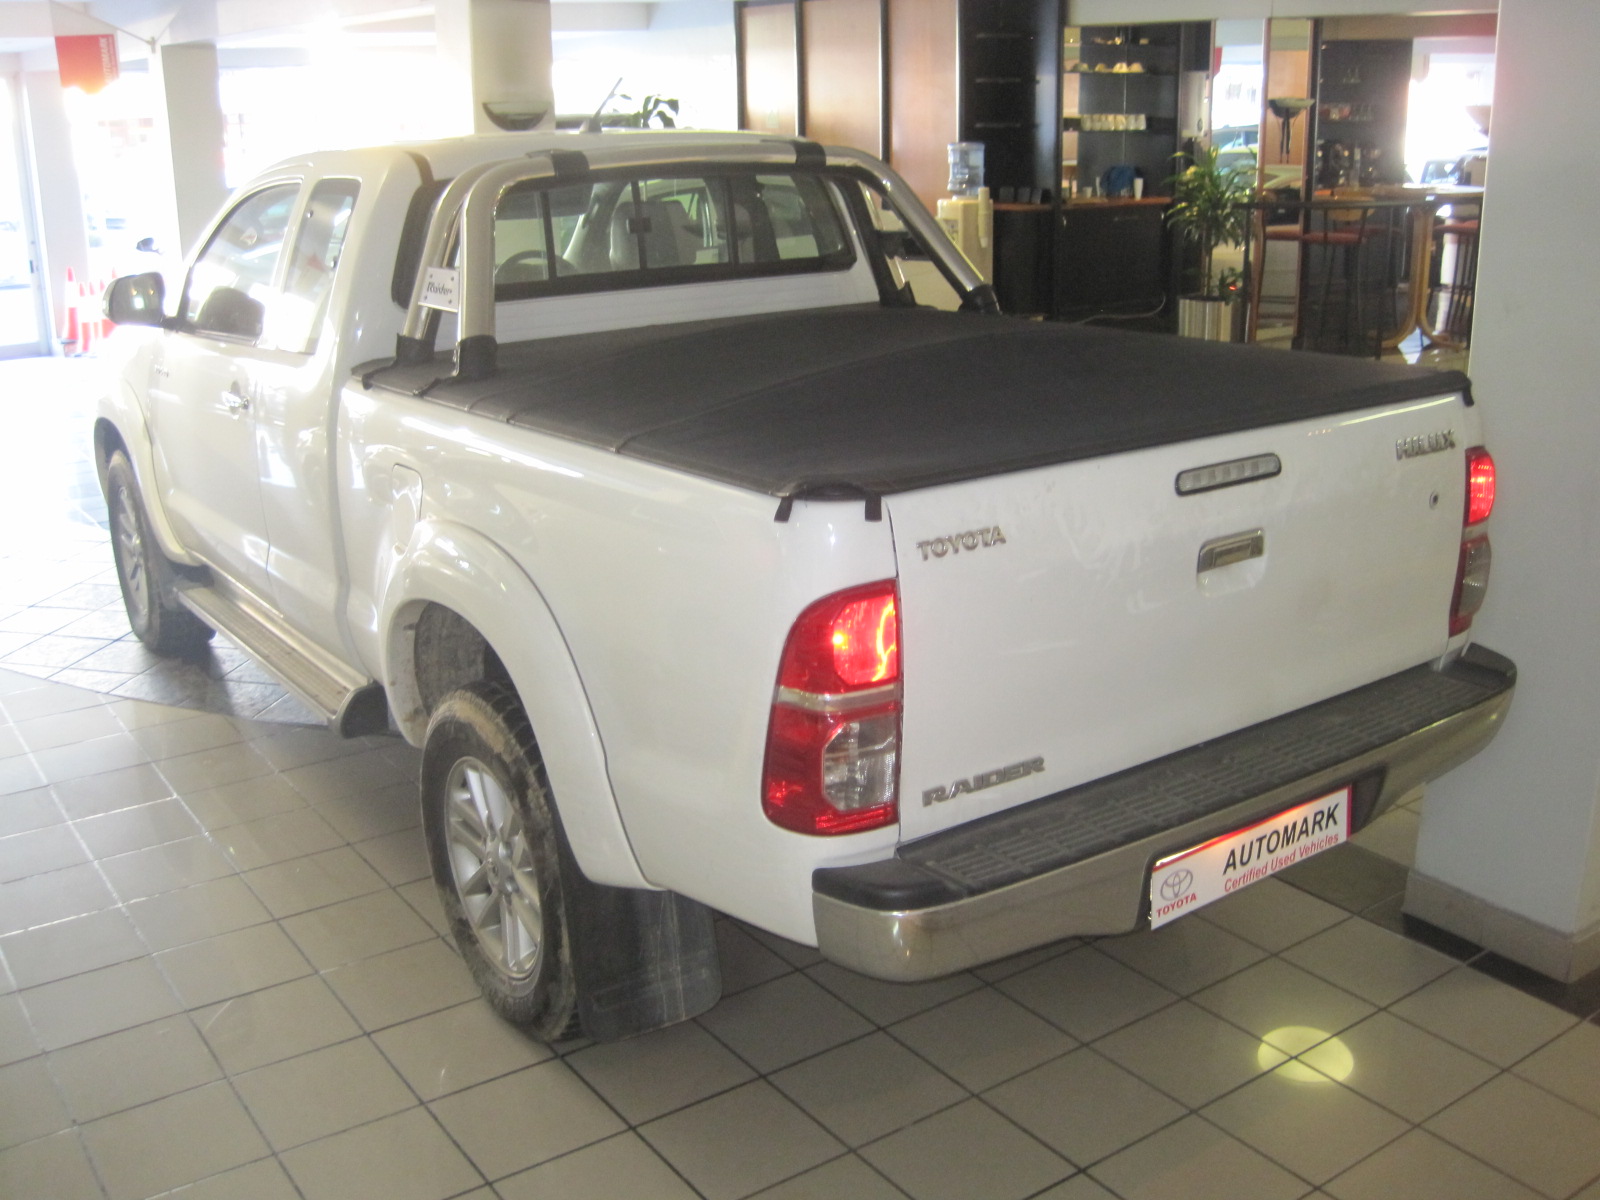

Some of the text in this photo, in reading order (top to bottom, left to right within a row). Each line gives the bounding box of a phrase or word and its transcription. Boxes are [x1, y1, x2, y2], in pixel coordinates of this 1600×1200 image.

[1396, 429, 1456, 461] HILUX
[916, 525, 1006, 561] TOYOTA
[922, 756, 1045, 807] RAIDER
[1223, 803, 1339, 875] AUTOMARK
[1224, 833, 1339, 893] Certified Used Vehicles
[1156, 892, 1197, 918] TOYOTA
